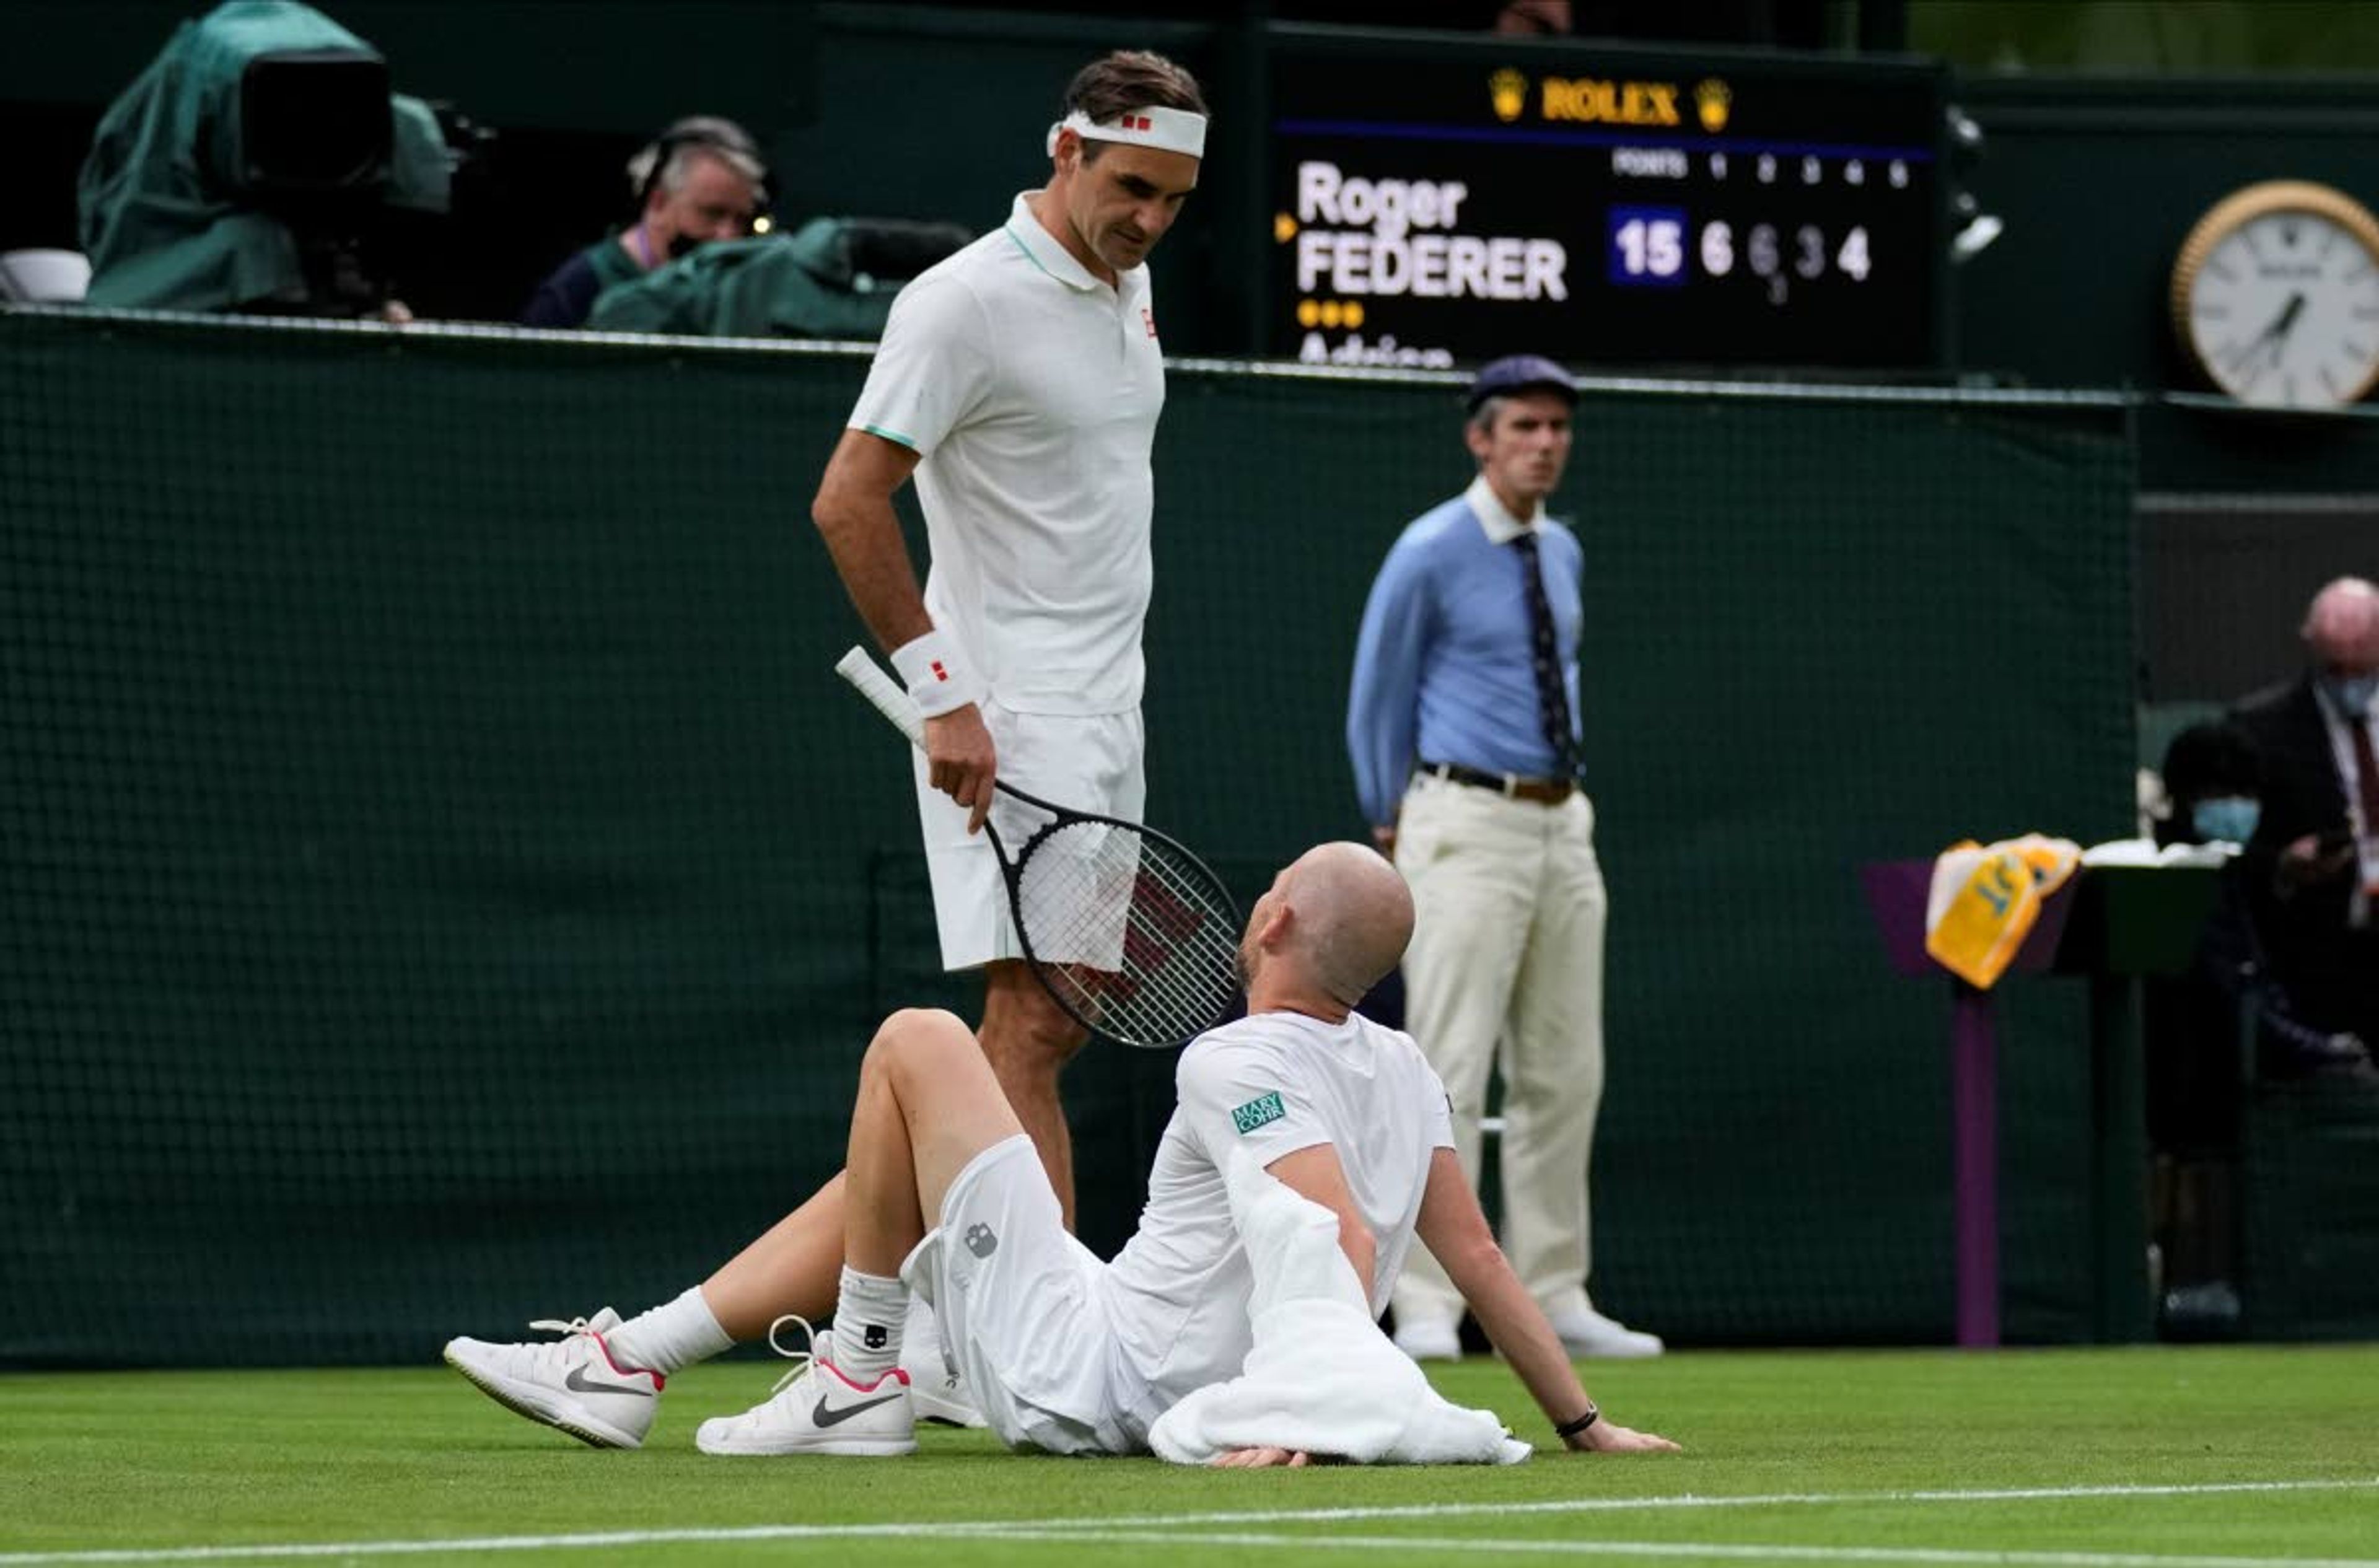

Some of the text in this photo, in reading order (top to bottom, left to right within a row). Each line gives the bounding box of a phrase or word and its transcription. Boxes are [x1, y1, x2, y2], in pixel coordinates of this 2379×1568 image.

[1542, 78, 1680, 126] ROLEX
[1612, 147, 1688, 178] POINTS
[1299, 161, 1467, 240] Roger
[1298, 232, 1568, 302] FEDERER
[1616, 219, 1871, 281] 15 6 6 3 4
[1234, 1093, 1277, 1121] MARY
[1239, 1106, 1284, 1131] COHR
